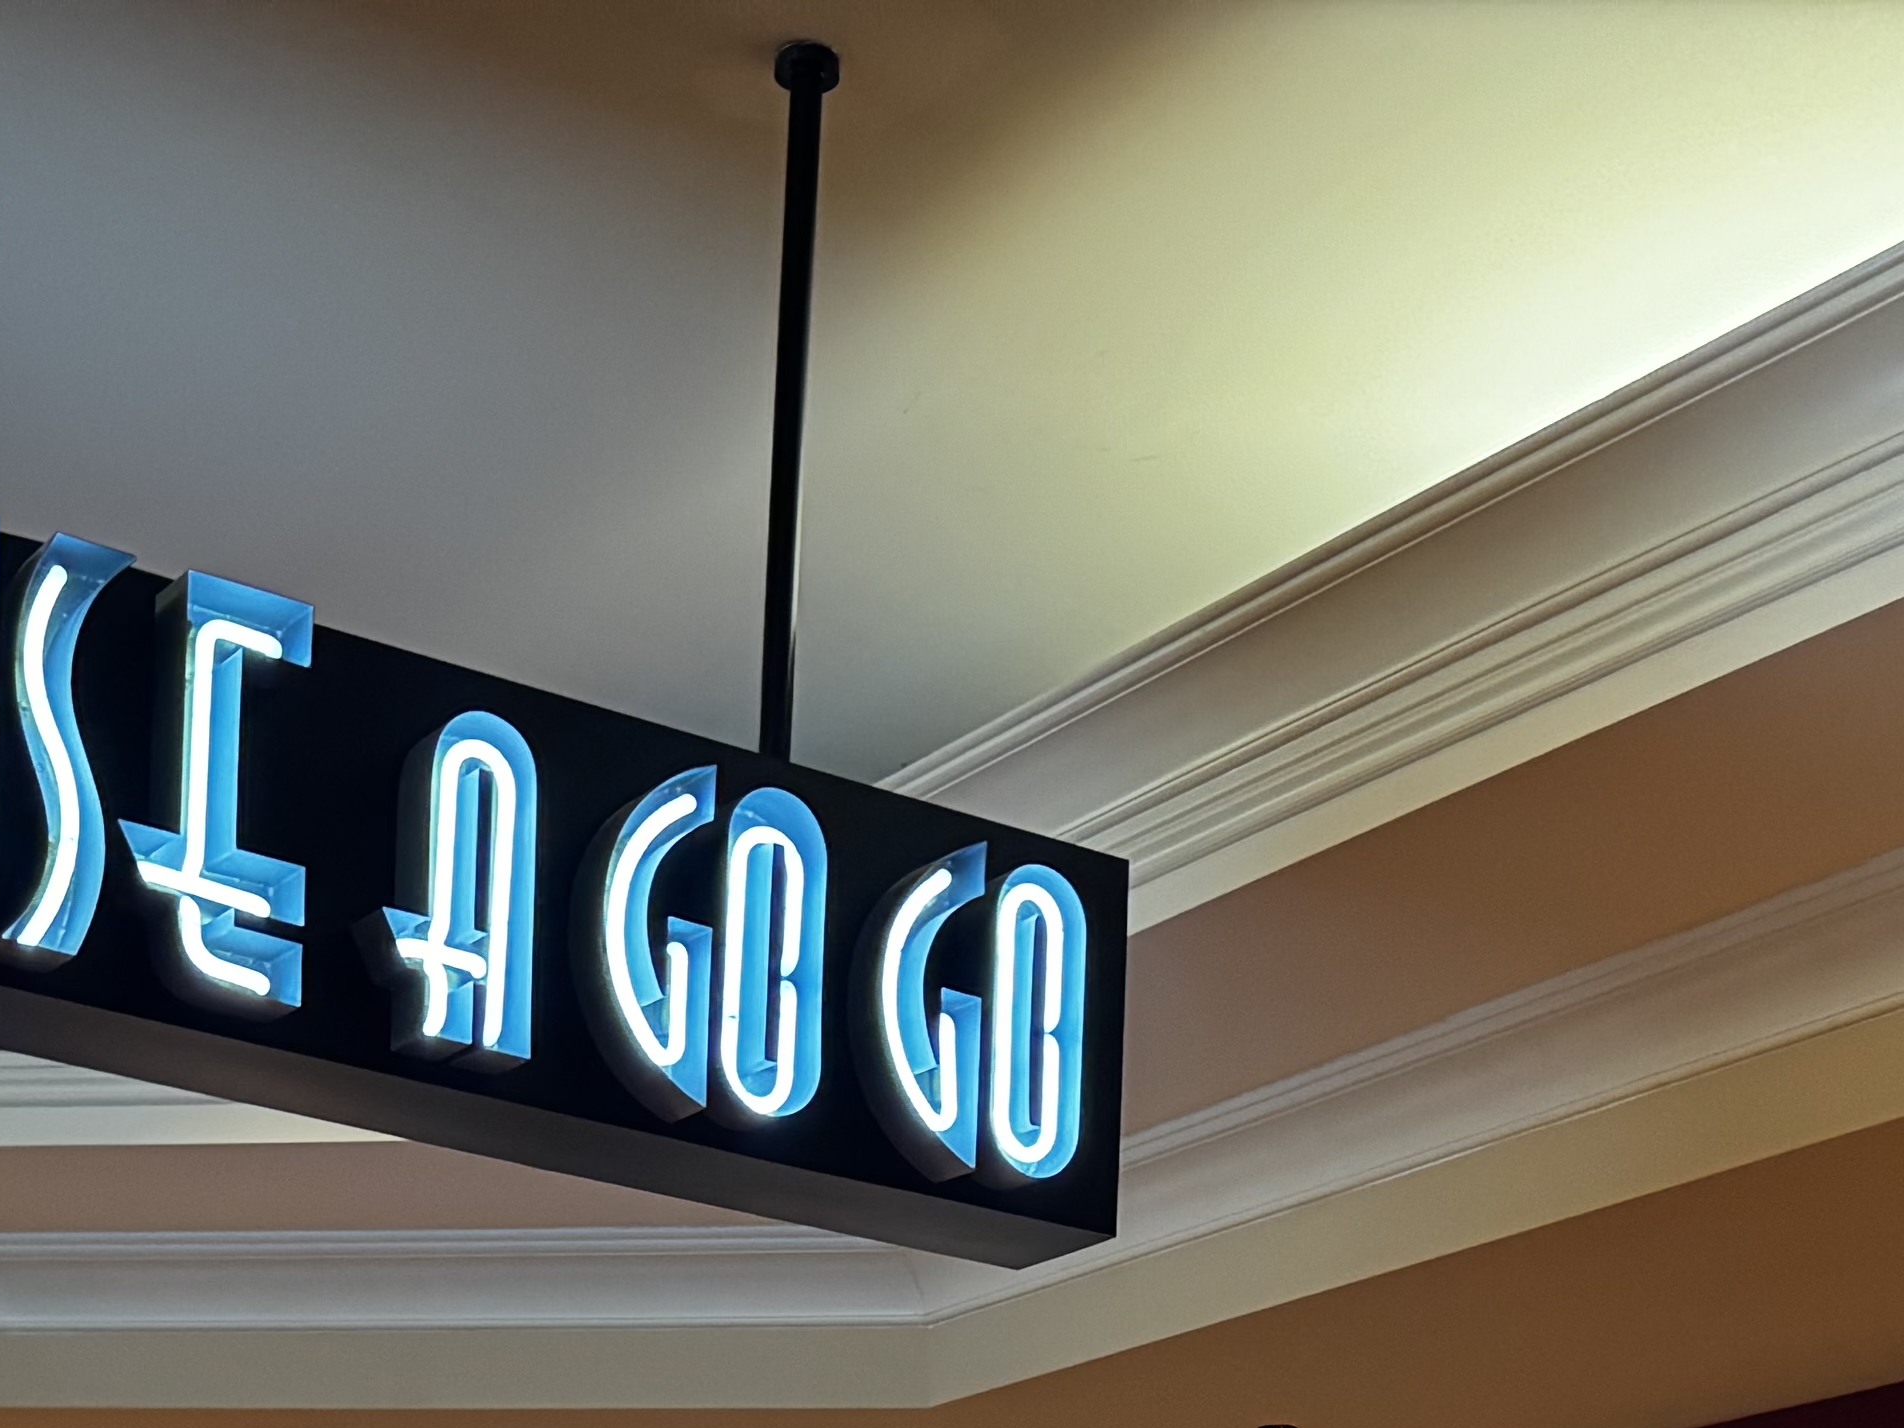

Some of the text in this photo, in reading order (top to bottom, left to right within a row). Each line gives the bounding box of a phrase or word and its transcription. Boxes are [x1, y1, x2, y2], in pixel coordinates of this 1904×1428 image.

[376, 710, 539, 1060] A
[596, 764, 828, 1118] GO
[878, 840, 1088, 1180] GO
